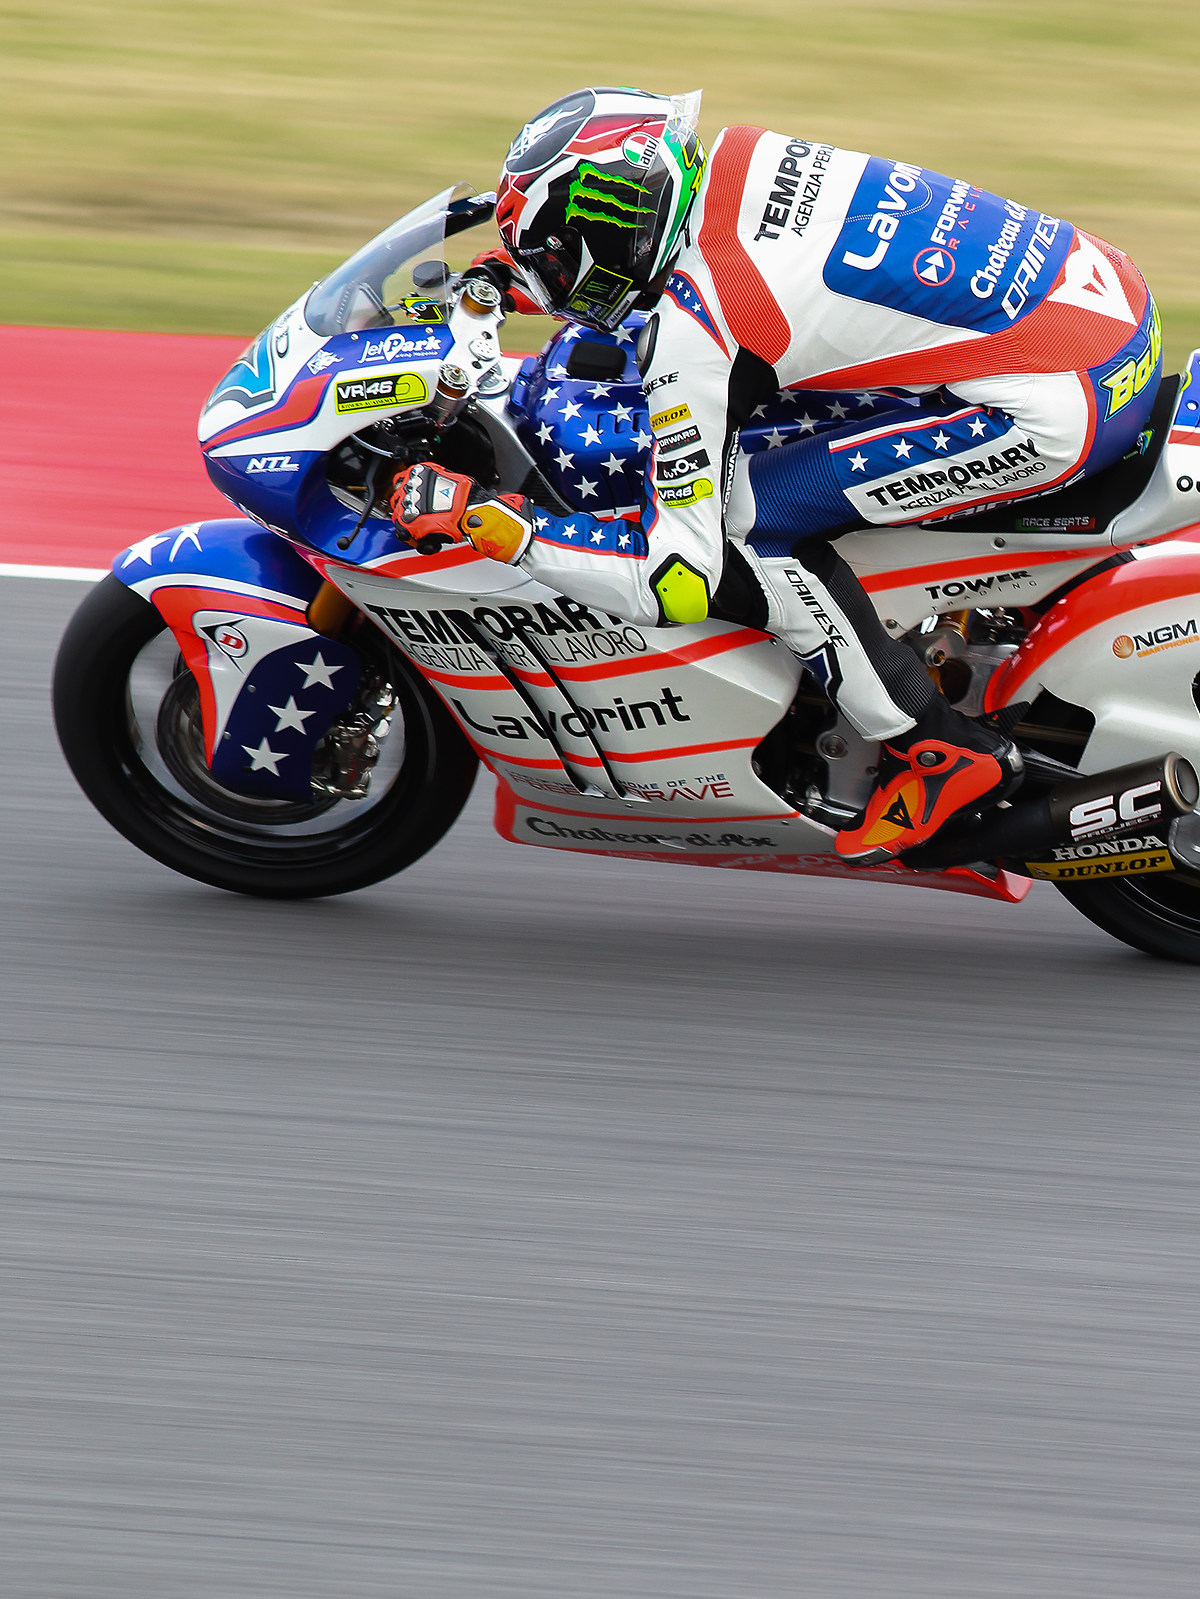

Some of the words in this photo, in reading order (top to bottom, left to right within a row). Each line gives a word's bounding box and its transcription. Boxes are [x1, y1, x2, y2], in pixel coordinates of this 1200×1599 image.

[791, 174, 824, 237] AGENZIA
[969, 218, 1023, 299] Chateau
[866, 438, 1041, 507] TEMPORARY
[997, 461, 1047, 487] LAVORO
[924, 570, 1033, 600] TOWER
[931, 580, 1038, 612] TRADING
[783, 569, 850, 648] DAINESE
[562, 626, 648, 663] LAVORO
[1133, 619, 1198, 651] NGM
[666, 780, 688, 788] OF
[694, 773, 727, 784] THE
[1070, 780, 1162, 838] SC
[1052, 835, 1167, 862] HONDA
[1057, 856, 1167, 878] DUNLOP
